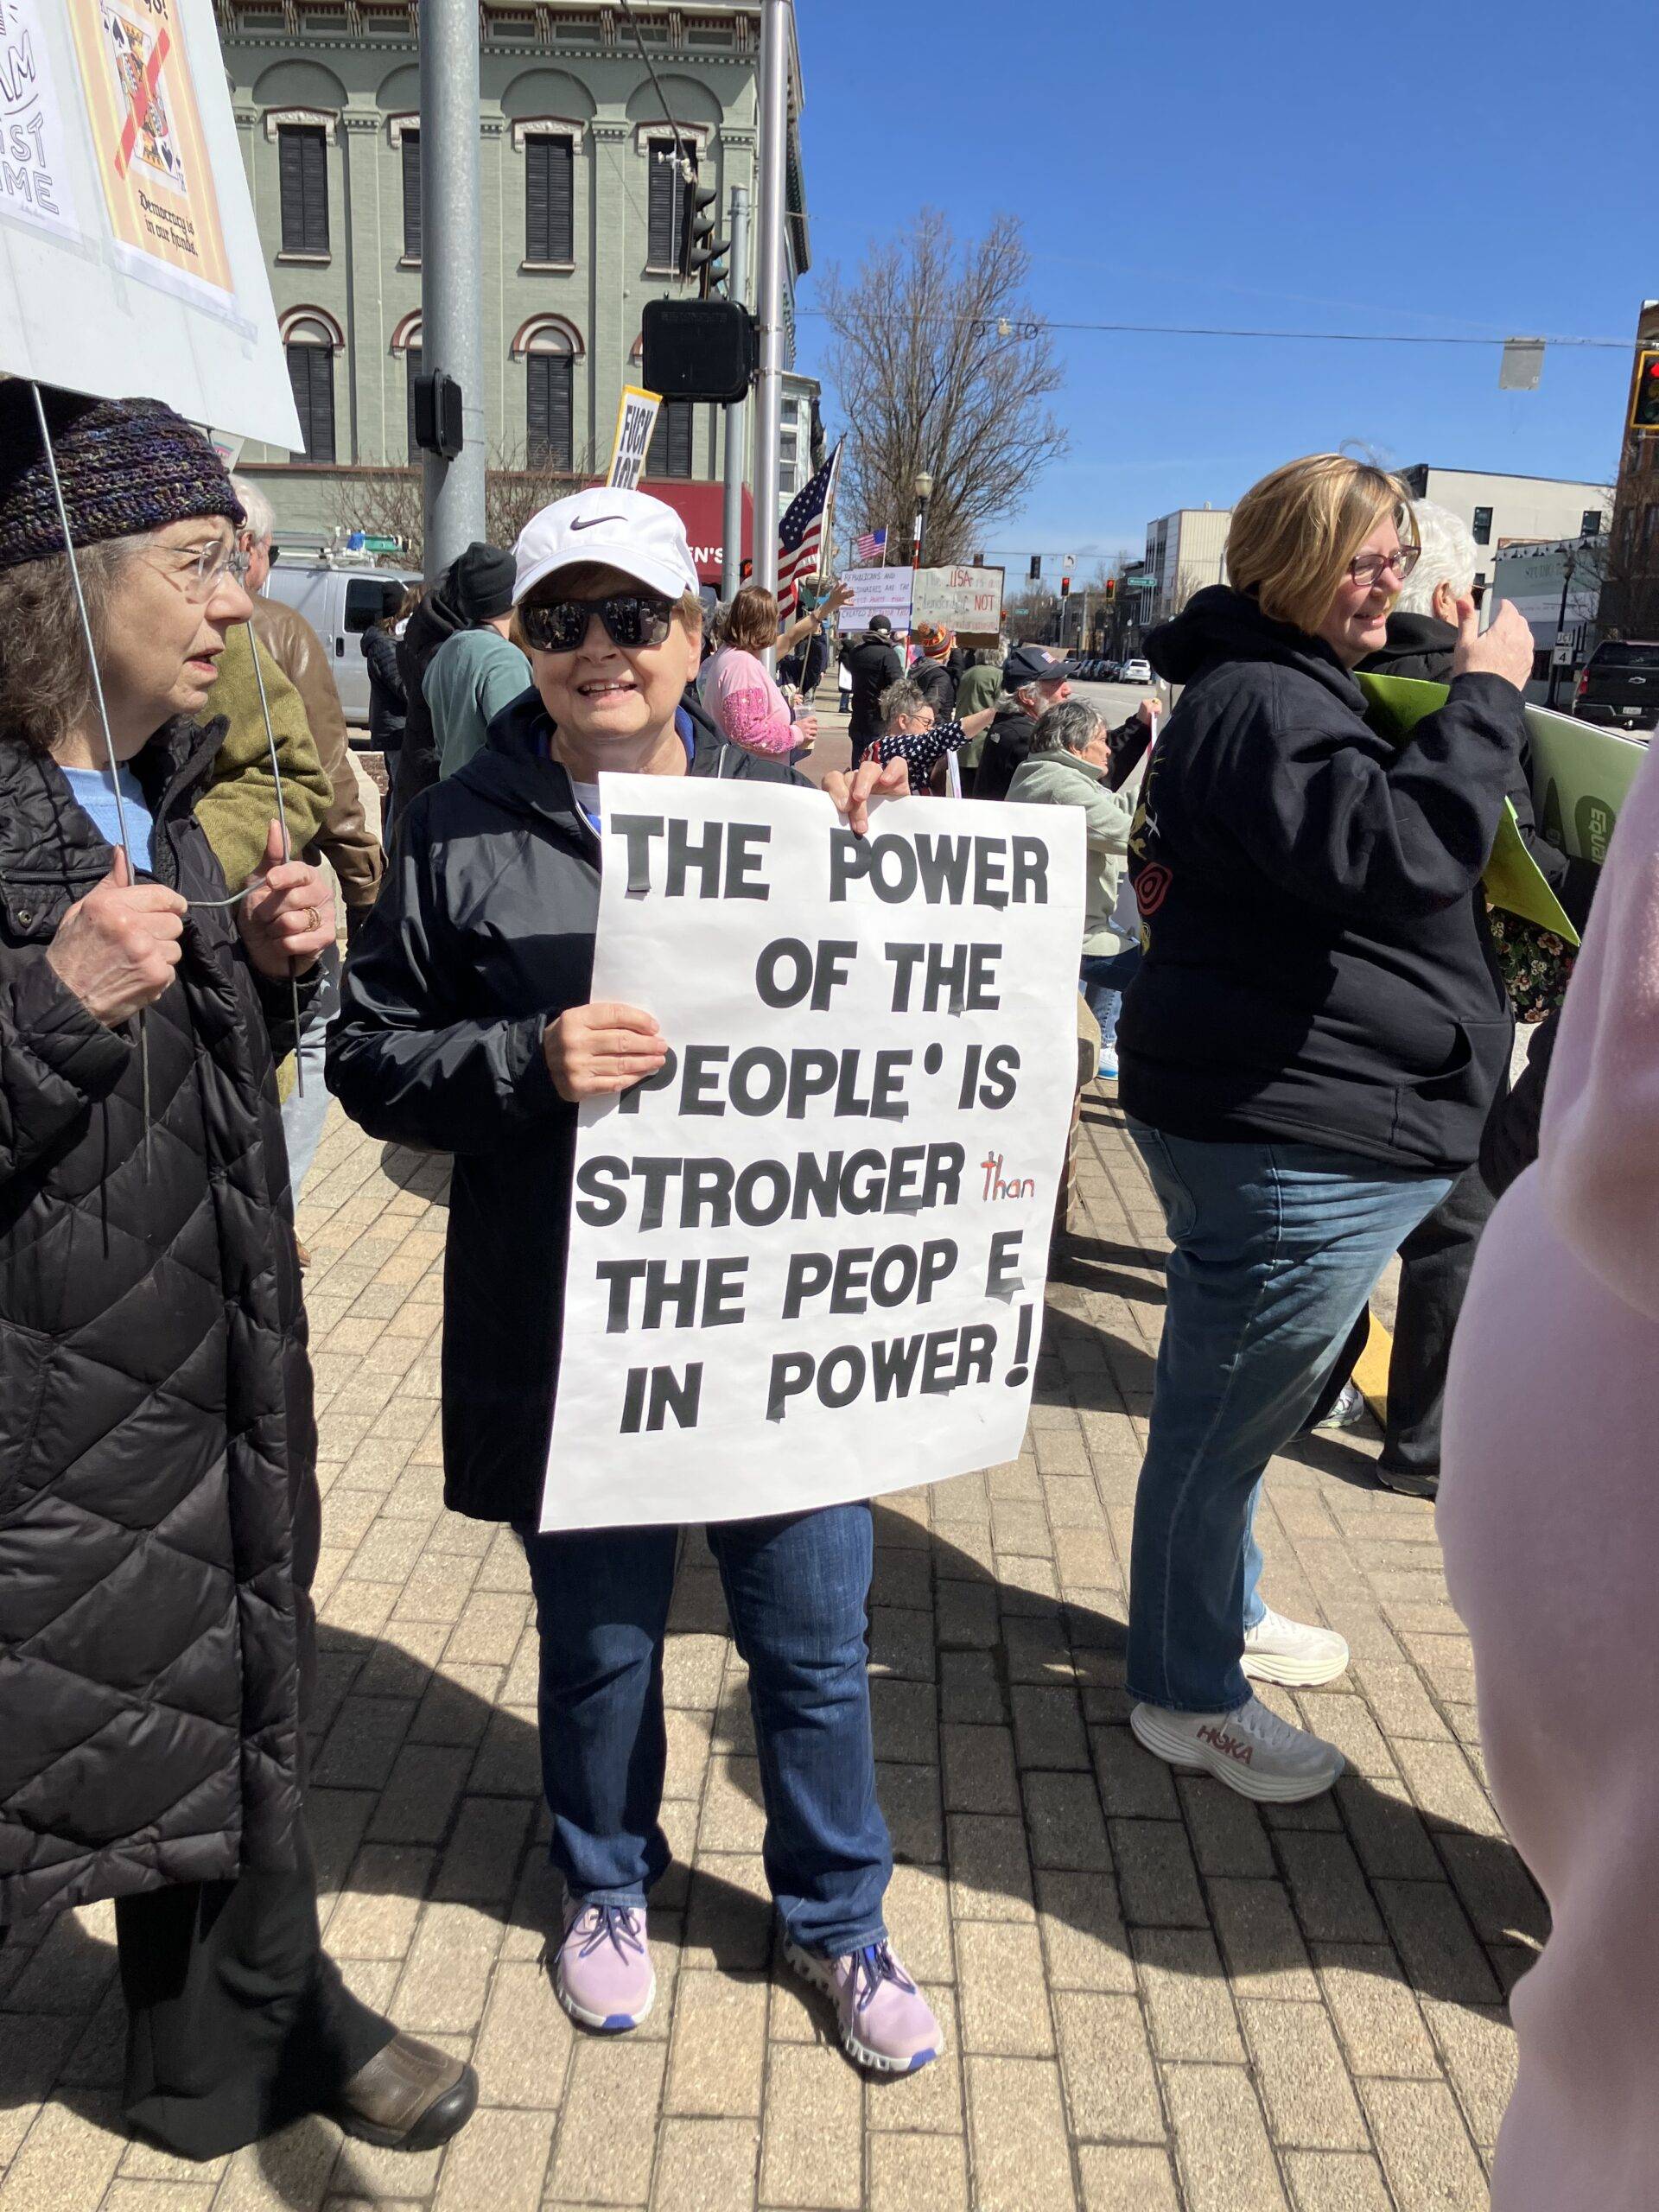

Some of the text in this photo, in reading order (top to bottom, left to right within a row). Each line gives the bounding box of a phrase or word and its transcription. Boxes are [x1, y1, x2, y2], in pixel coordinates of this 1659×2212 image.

[0, 161, 60, 214] ME
[138, 189, 195, 235] Democracy is
[144, 214, 156, 235] in
[156, 225, 170, 243] our
[620, 404, 654, 455] FUCK
[688, 546, 723, 564] N'S
[950, 569, 972, 588] USA
[974, 594, 995, 611] NOT
[1559, 652, 1567, 663] 4
[611, 814, 1050, 910] THE POWER
[756, 938, 1002, 1017] OF THE
[958, 1045, 1020, 1109] IS
[575, 1141, 1035, 1233] STRONGER than
[596, 1256, 749, 1334] THE
[620, 1304, 1033, 1433] IN POWER!
[1197, 1725, 1253, 1764] HOKA
